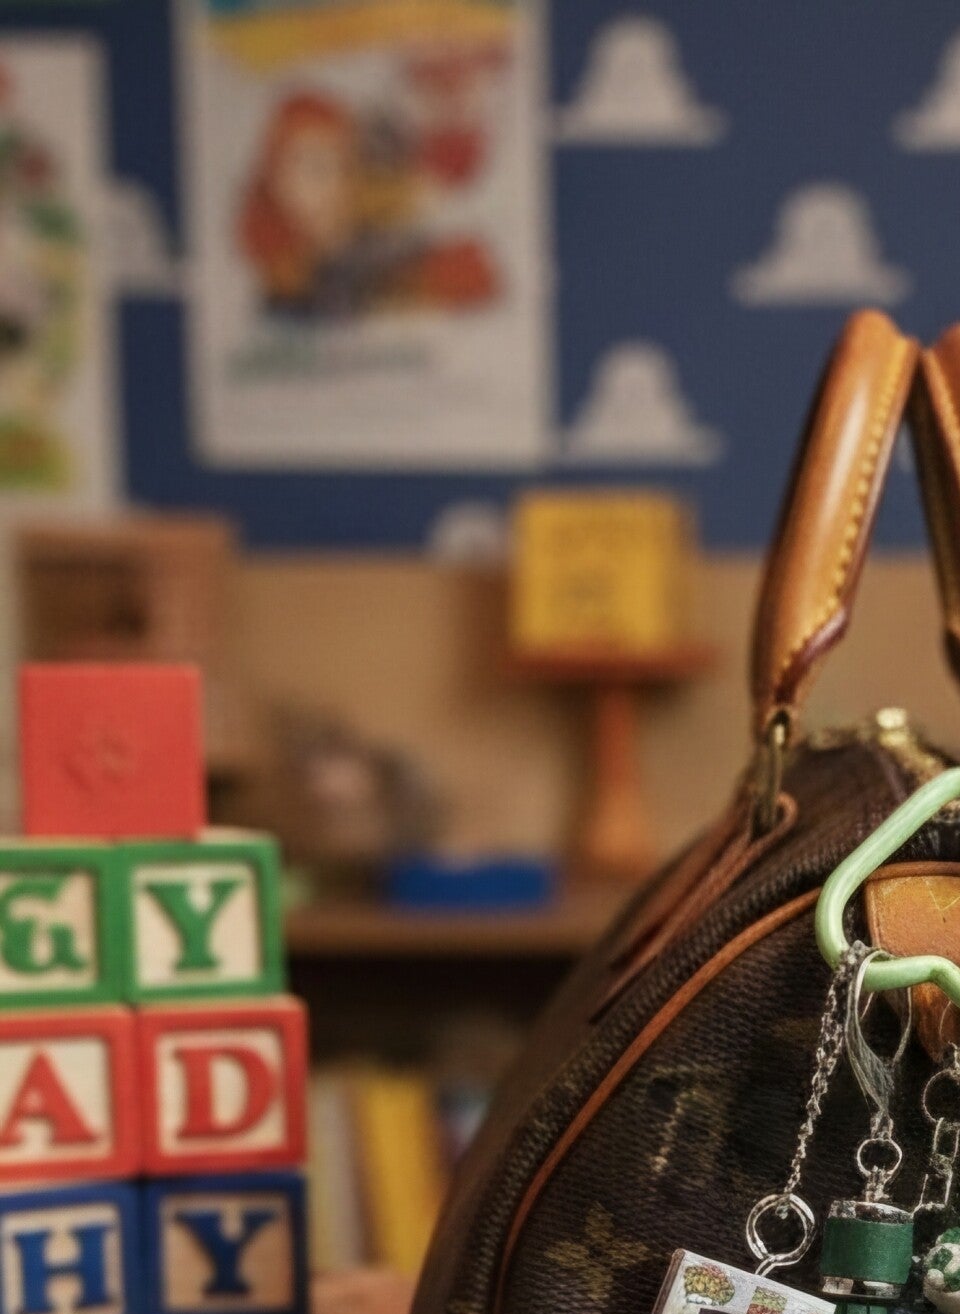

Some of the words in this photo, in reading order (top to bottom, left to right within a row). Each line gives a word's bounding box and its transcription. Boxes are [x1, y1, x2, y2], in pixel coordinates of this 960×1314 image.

[143, 879, 245, 970] Y
[172, 1047, 276, 1139] D
[173, 1209, 277, 1297] Y
